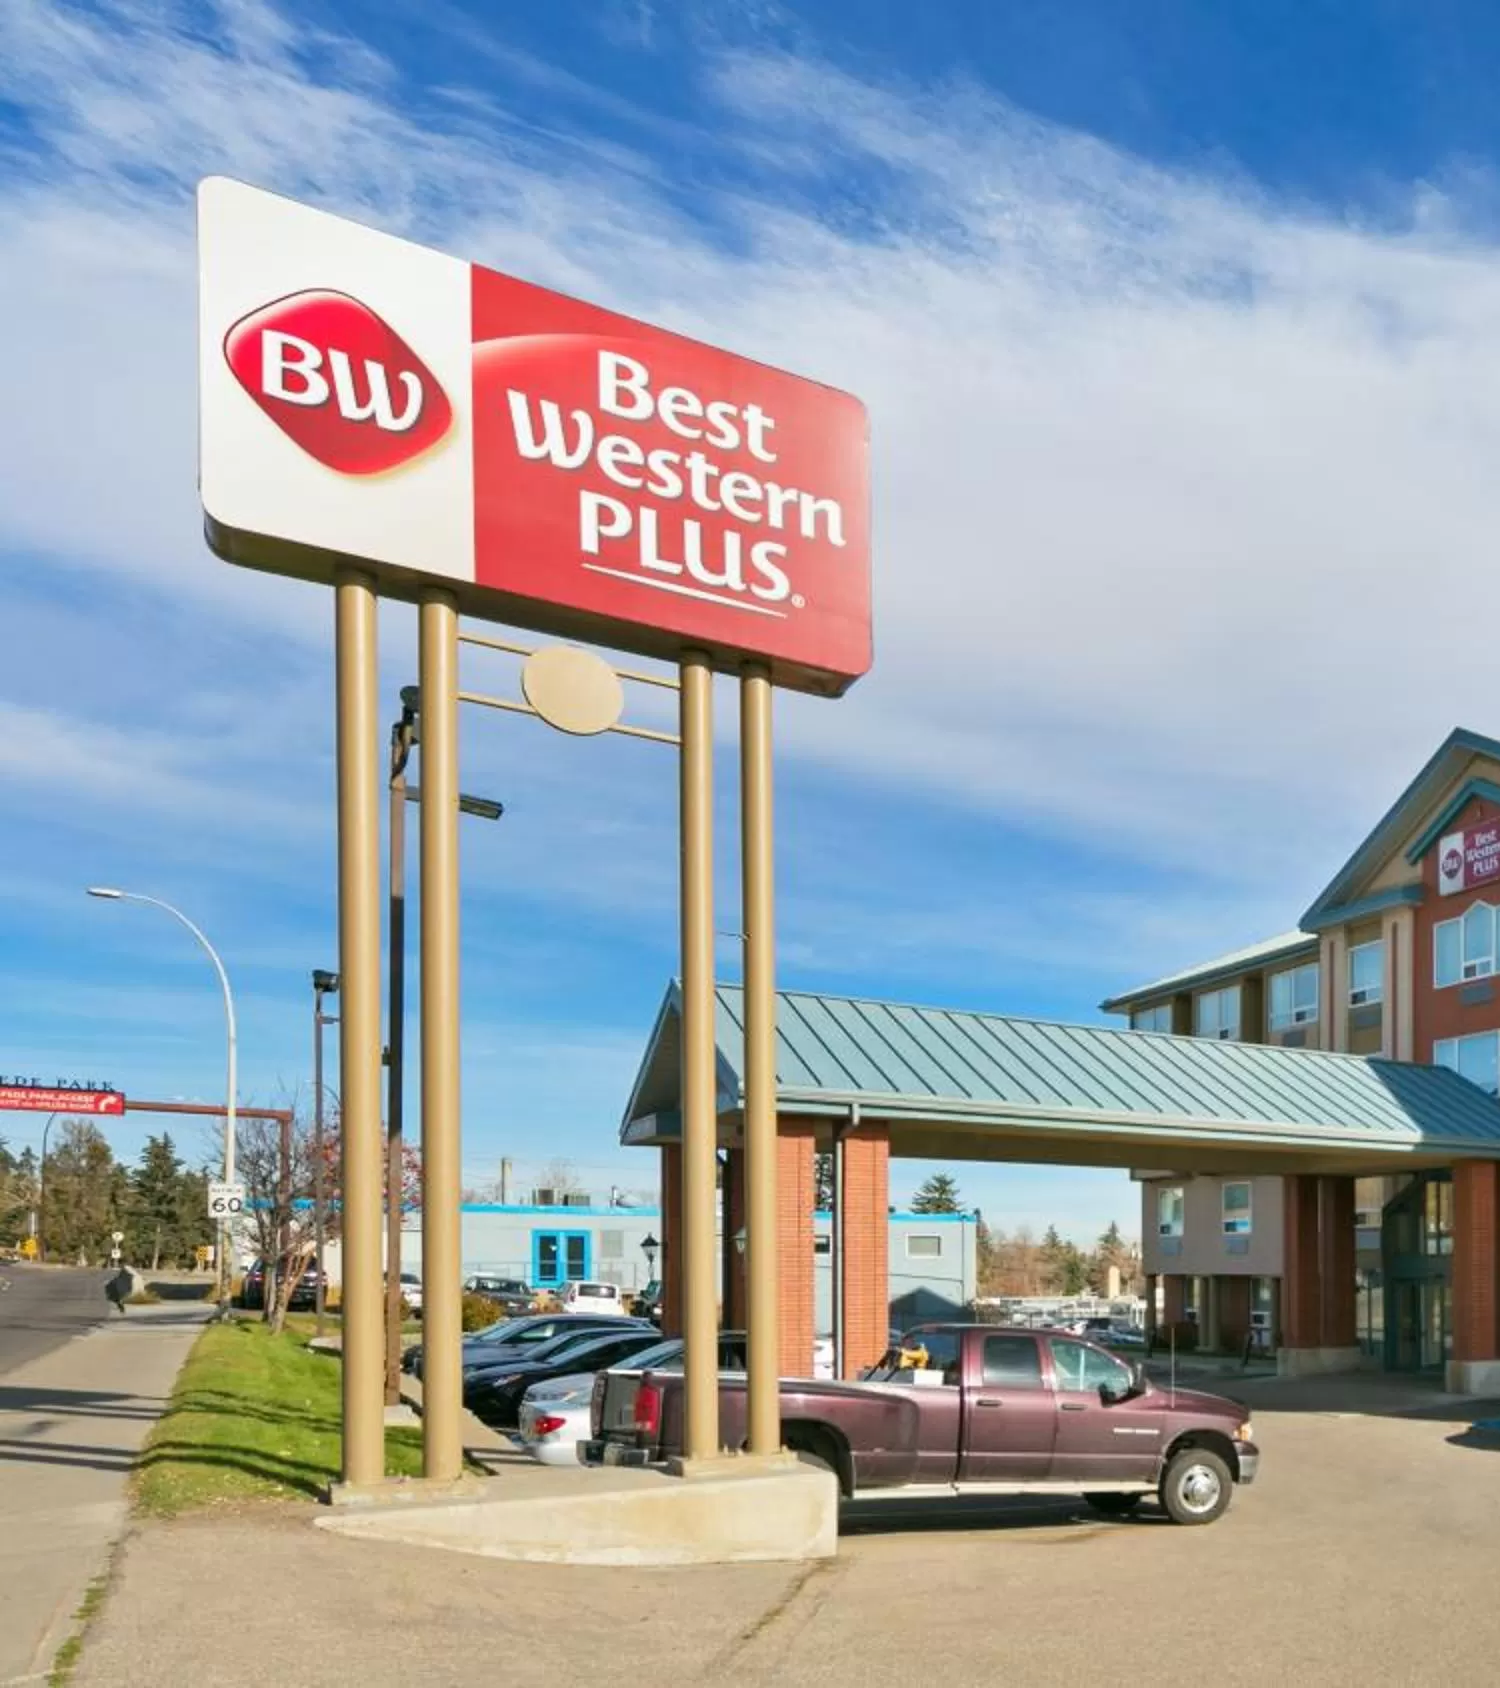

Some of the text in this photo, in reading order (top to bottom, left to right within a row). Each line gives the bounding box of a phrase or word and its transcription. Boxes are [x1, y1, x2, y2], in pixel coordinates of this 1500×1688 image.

[261, 328, 423, 432] BW
[598, 349, 777, 463] Best
[506, 387, 847, 547] Western
[212, 1197, 242, 1213] 60
